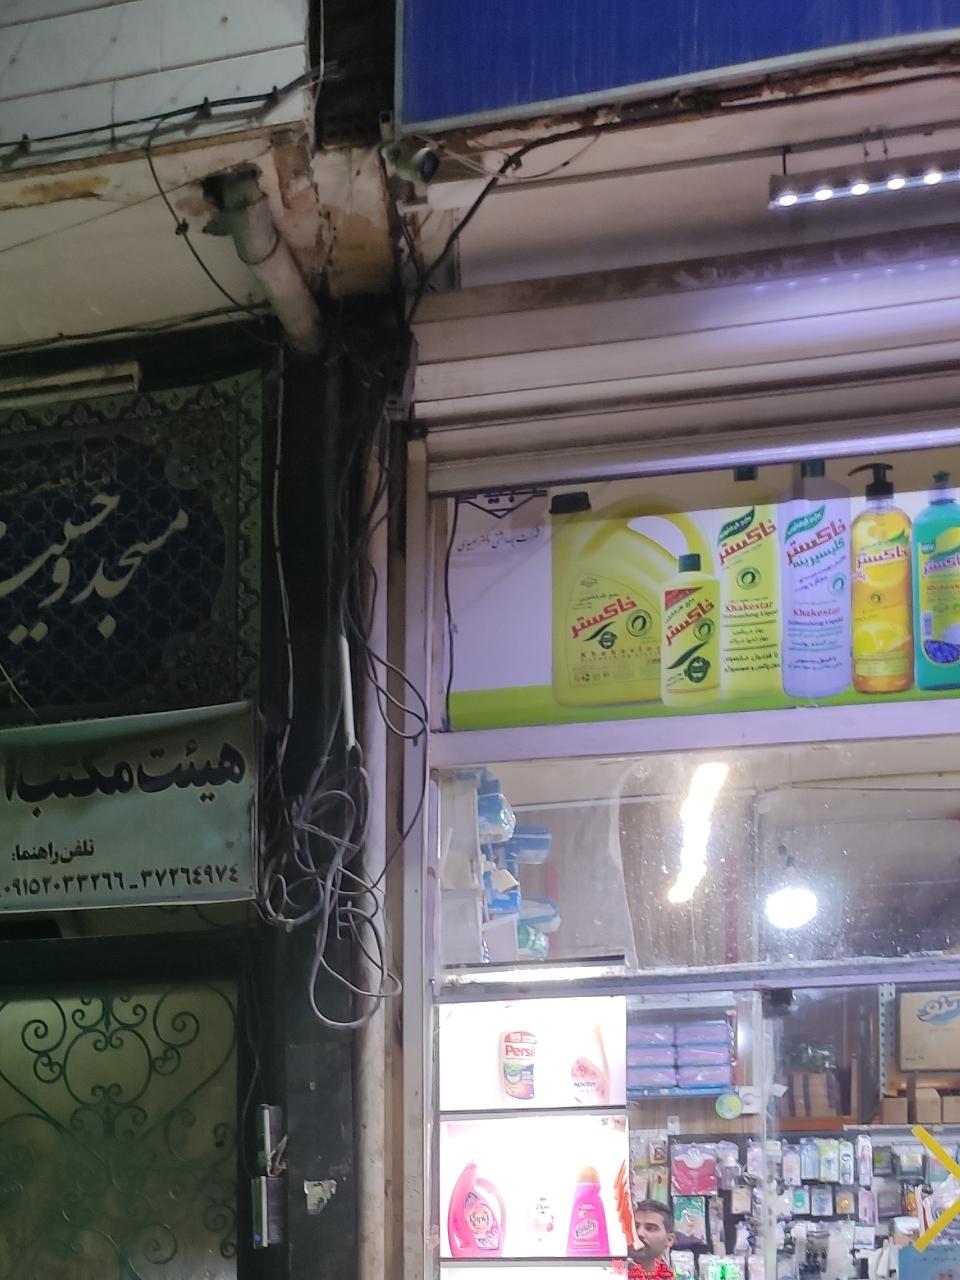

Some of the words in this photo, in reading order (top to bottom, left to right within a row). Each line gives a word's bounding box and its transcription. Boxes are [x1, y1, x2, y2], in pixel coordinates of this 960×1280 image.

[719, 518, 777, 567] خاکستر
[786, 517, 847, 567] خاکستر
[570, 596, 638, 640] خاکستر
[665, 598, 716, 647] خاکستر
[137, 738, 246, 804] هیئت
[61, 838, 96, 864] تلفن
